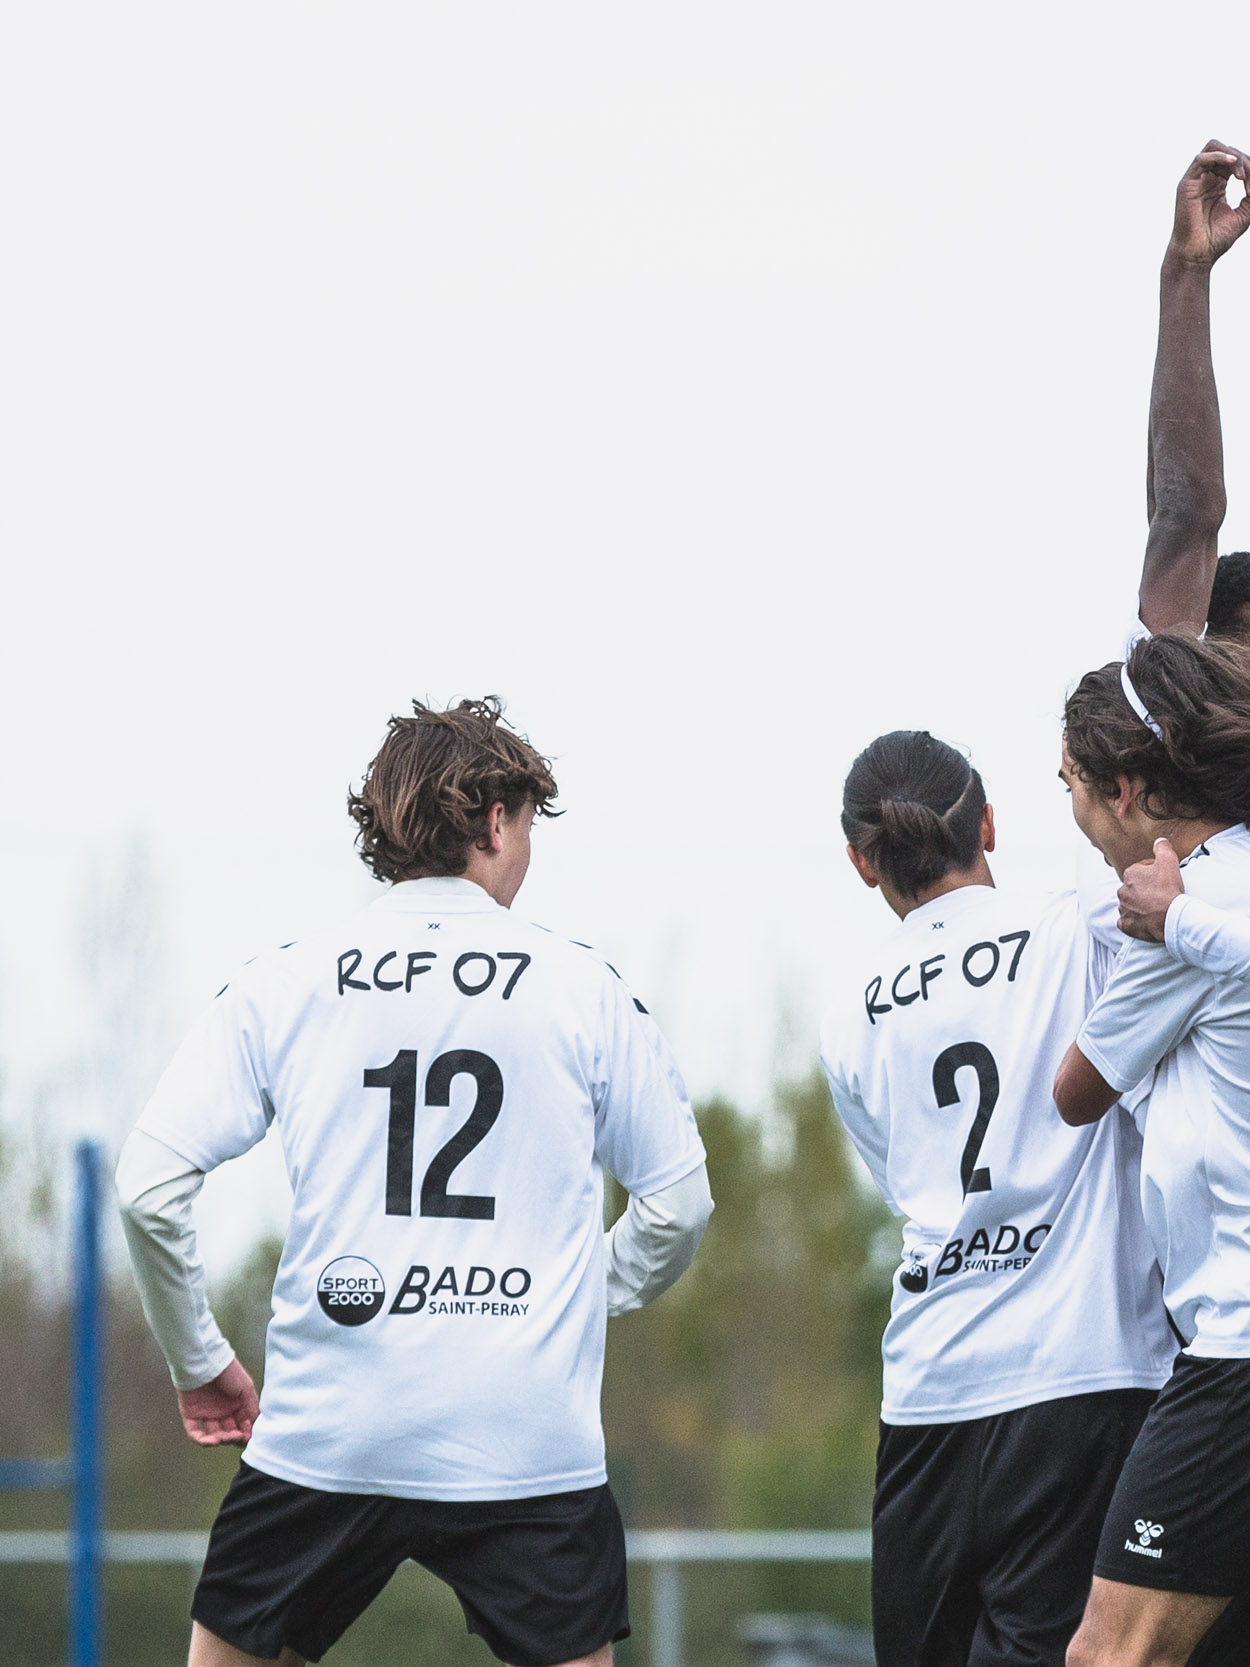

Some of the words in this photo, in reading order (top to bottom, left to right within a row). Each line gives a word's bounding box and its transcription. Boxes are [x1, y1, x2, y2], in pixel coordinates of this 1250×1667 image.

[337, 948, 437, 996] RCF
[452, 951, 532, 1000] 07
[865, 954, 946, 1025] RCF
[962, 930, 1031, 988] 07
[363, 1048, 504, 1221] 12
[932, 1041, 1000, 1201] 2
[323, 1277, 379, 1290] SPORT
[328, 1293, 375, 1306] 2000
[387, 1265, 532, 1316] BADO
[428, 1301, 530, 1317] SAINT-PERAY
[1124, 1538, 1163, 1559] hummel
